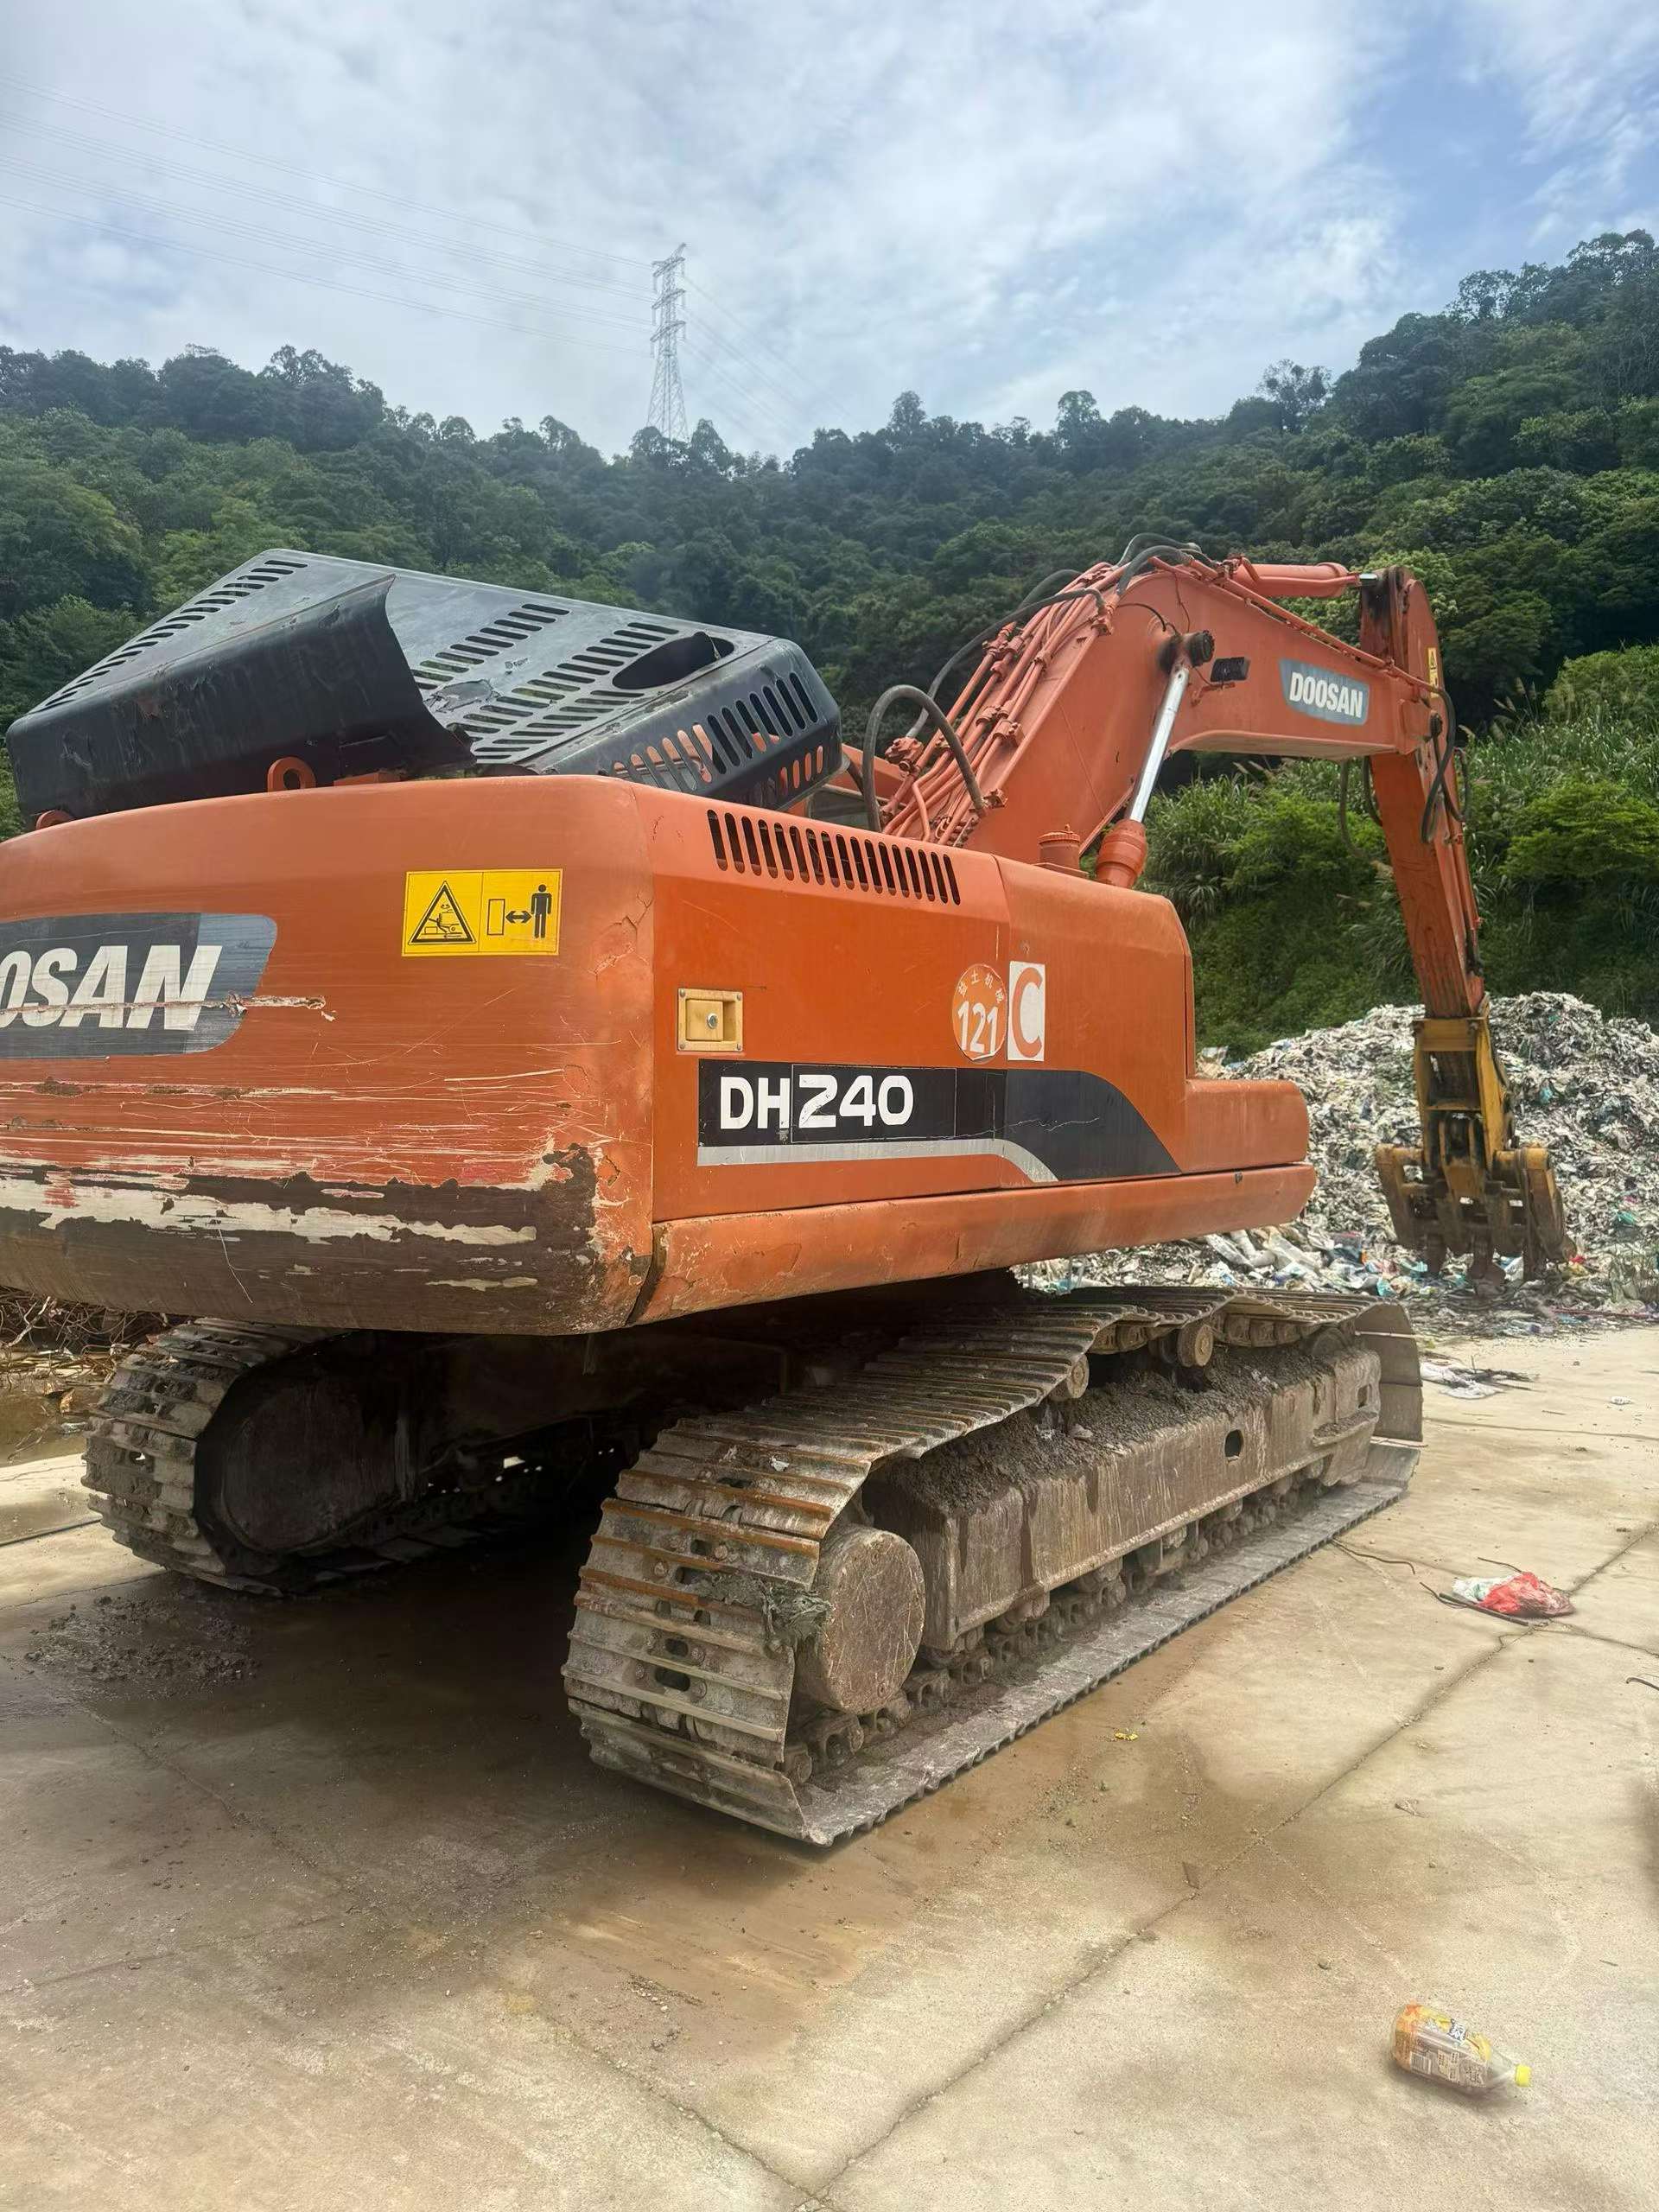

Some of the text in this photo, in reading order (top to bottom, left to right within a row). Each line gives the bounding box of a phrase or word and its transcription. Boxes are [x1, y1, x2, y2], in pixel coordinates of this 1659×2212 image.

[1288, 671, 1363, 718] DOOSAN
[957, 1001, 998, 1055] 121
[1012, 967, 1043, 1058] C
[721, 1074, 913, 1129] DH240
